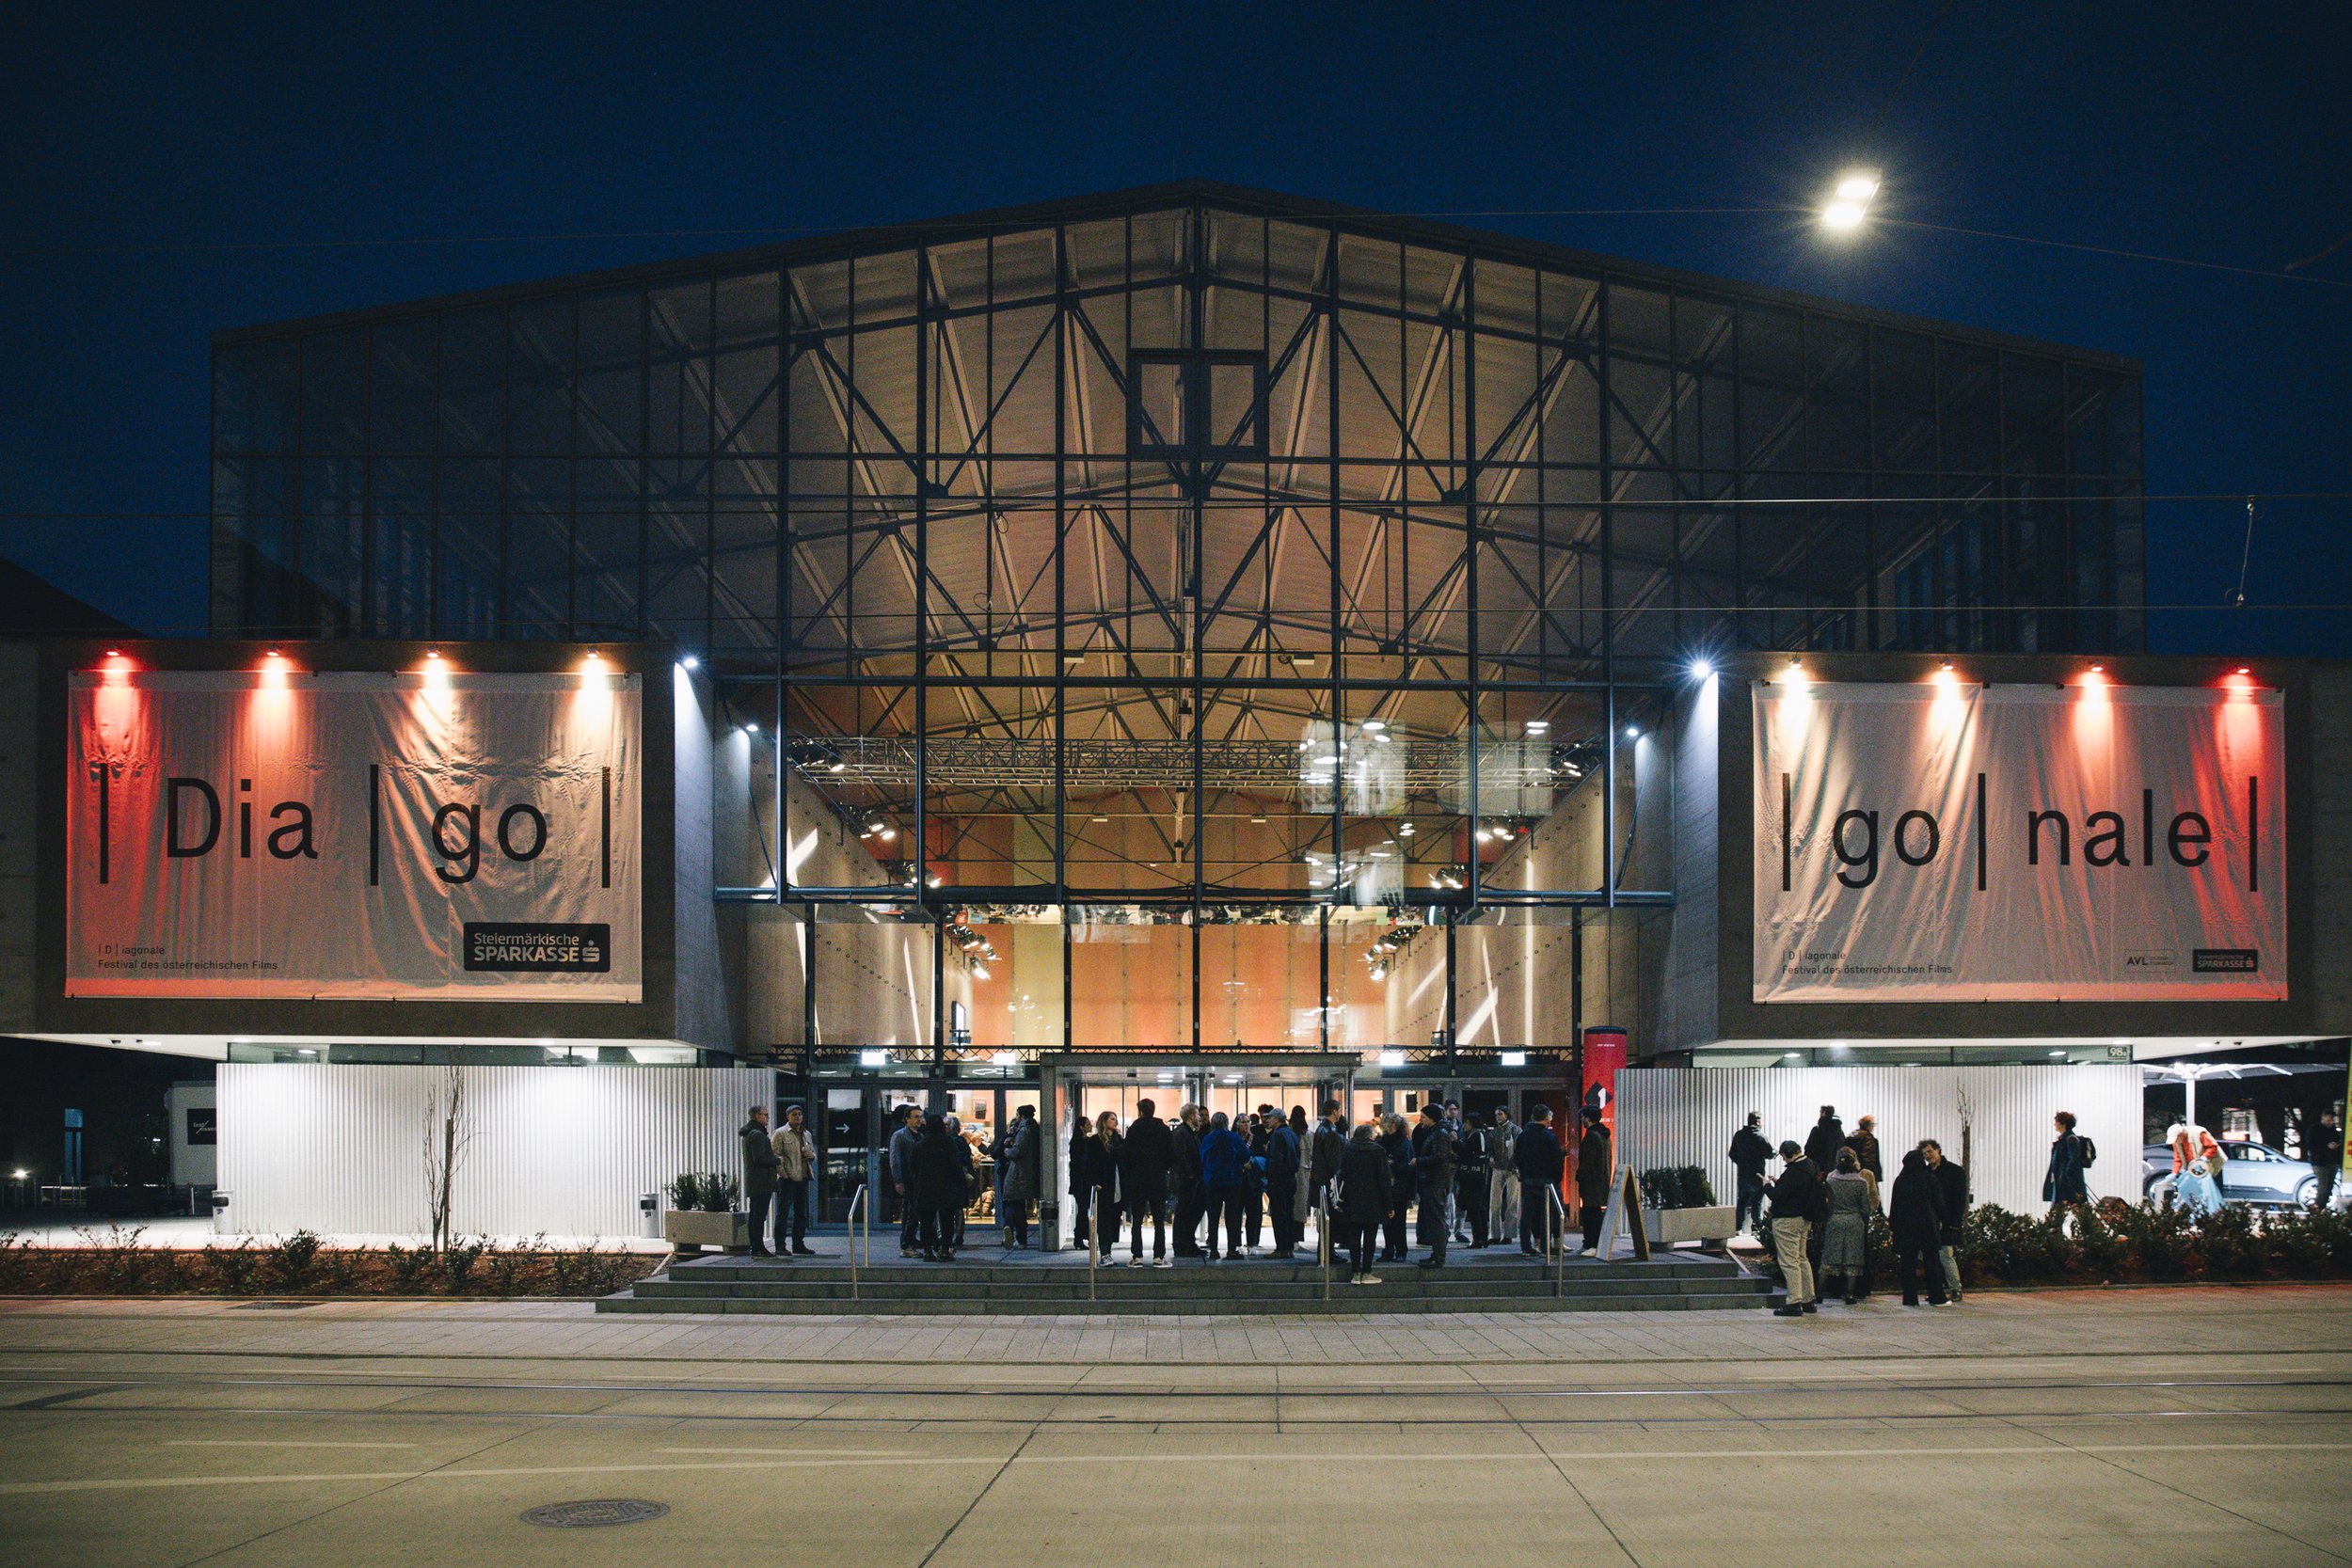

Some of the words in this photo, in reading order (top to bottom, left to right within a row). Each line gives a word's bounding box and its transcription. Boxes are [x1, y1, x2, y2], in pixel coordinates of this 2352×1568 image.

[167, 777, 318, 860] Dia
[432, 802, 548, 884] go
[1834, 808, 1940, 889] go
[2028, 789, 2212, 867] nale
[474, 932, 580, 945] Steiermärkische
[122, 944, 165, 957] iagonale
[473, 946, 580, 962] SPARKASSE
[98, 959, 137, 969] Festival
[141, 960, 159, 970] des
[163, 960, 248, 970] österreichischen
[253, 960, 278, 970] Films
[2127, 957, 2148, 965] AVL
[1782, 965, 1820, 974] Festival
[1823, 965, 1841, 974] des
[1844, 965, 1925, 974] österreichischen
[1929, 965, 1953, 974] Films
